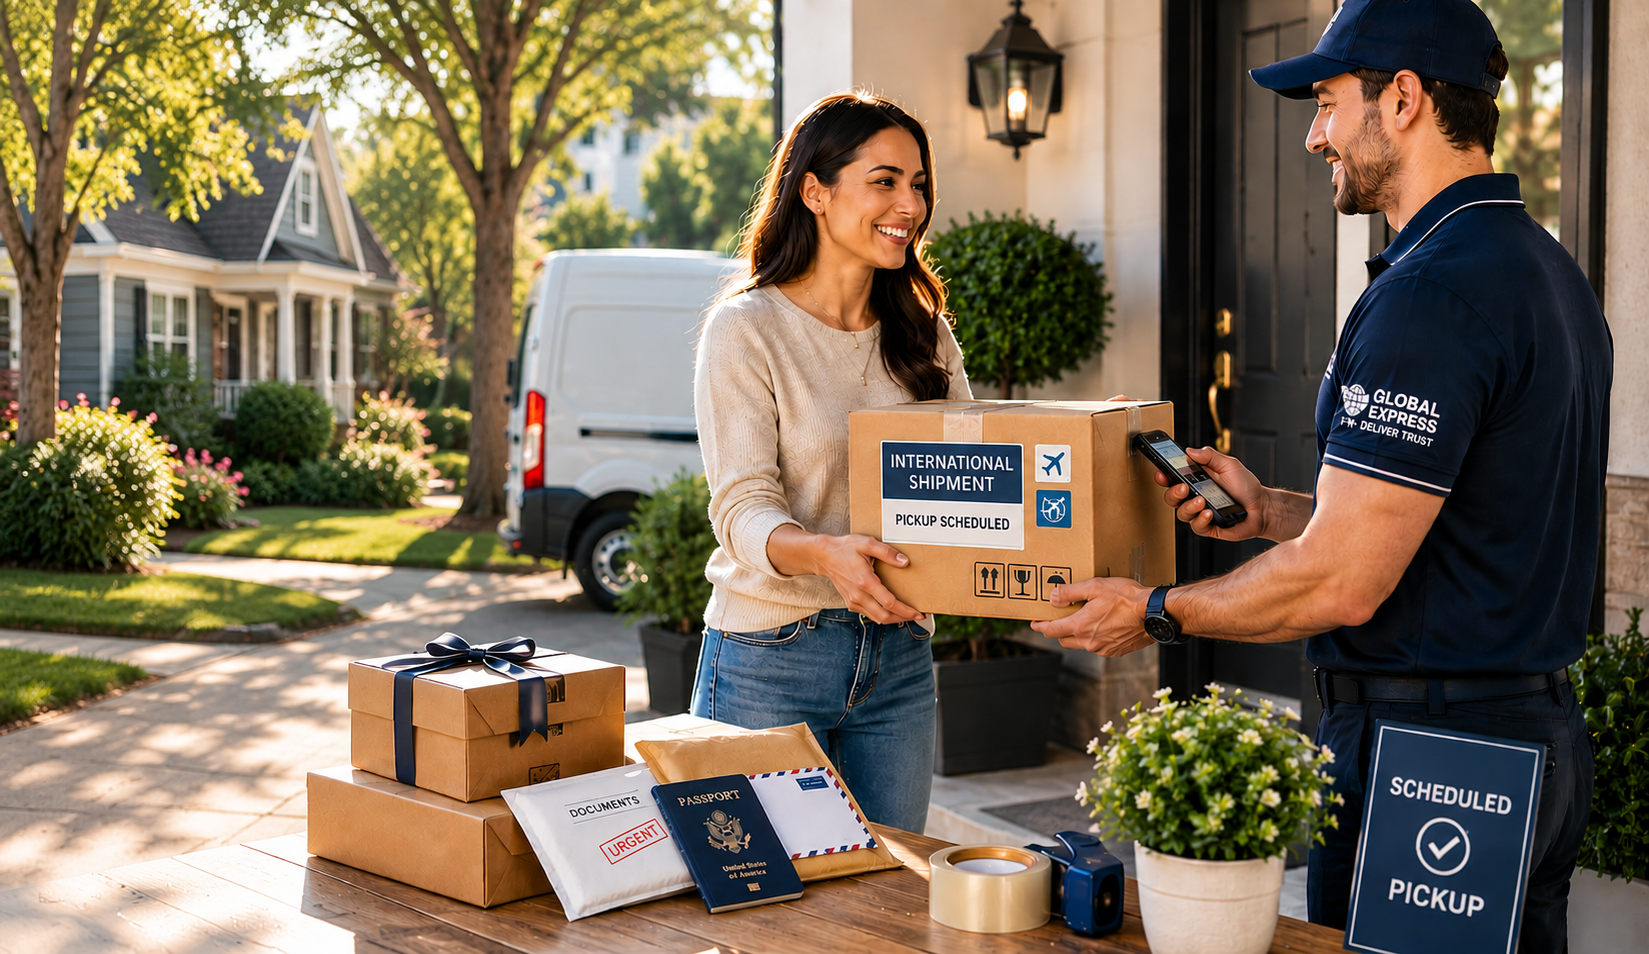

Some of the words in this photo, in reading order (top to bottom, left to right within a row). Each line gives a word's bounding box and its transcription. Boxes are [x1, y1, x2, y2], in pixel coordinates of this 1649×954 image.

[1373, 388, 1441, 418] GLOBAL
[1368, 405, 1438, 434] EXPRESS
[1360, 420, 1399, 438] DELIVER
[1401, 430, 1433, 448] TRUST
[891, 454, 1014, 471] INTERNATIONAL
[909, 475, 995, 492] SHIPMENT
[896, 514, 937, 527] PICKUP
[940, 516, 1010, 530] SCHEDULED
[568, 795, 640, 819] DOCUMENTS
[677, 789, 740, 806] PASSPORT
[1390, 776, 1512, 815] SCHEDULED
[607, 825, 658, 858] URGENT
[1388, 878, 1485, 917] PICKUP
